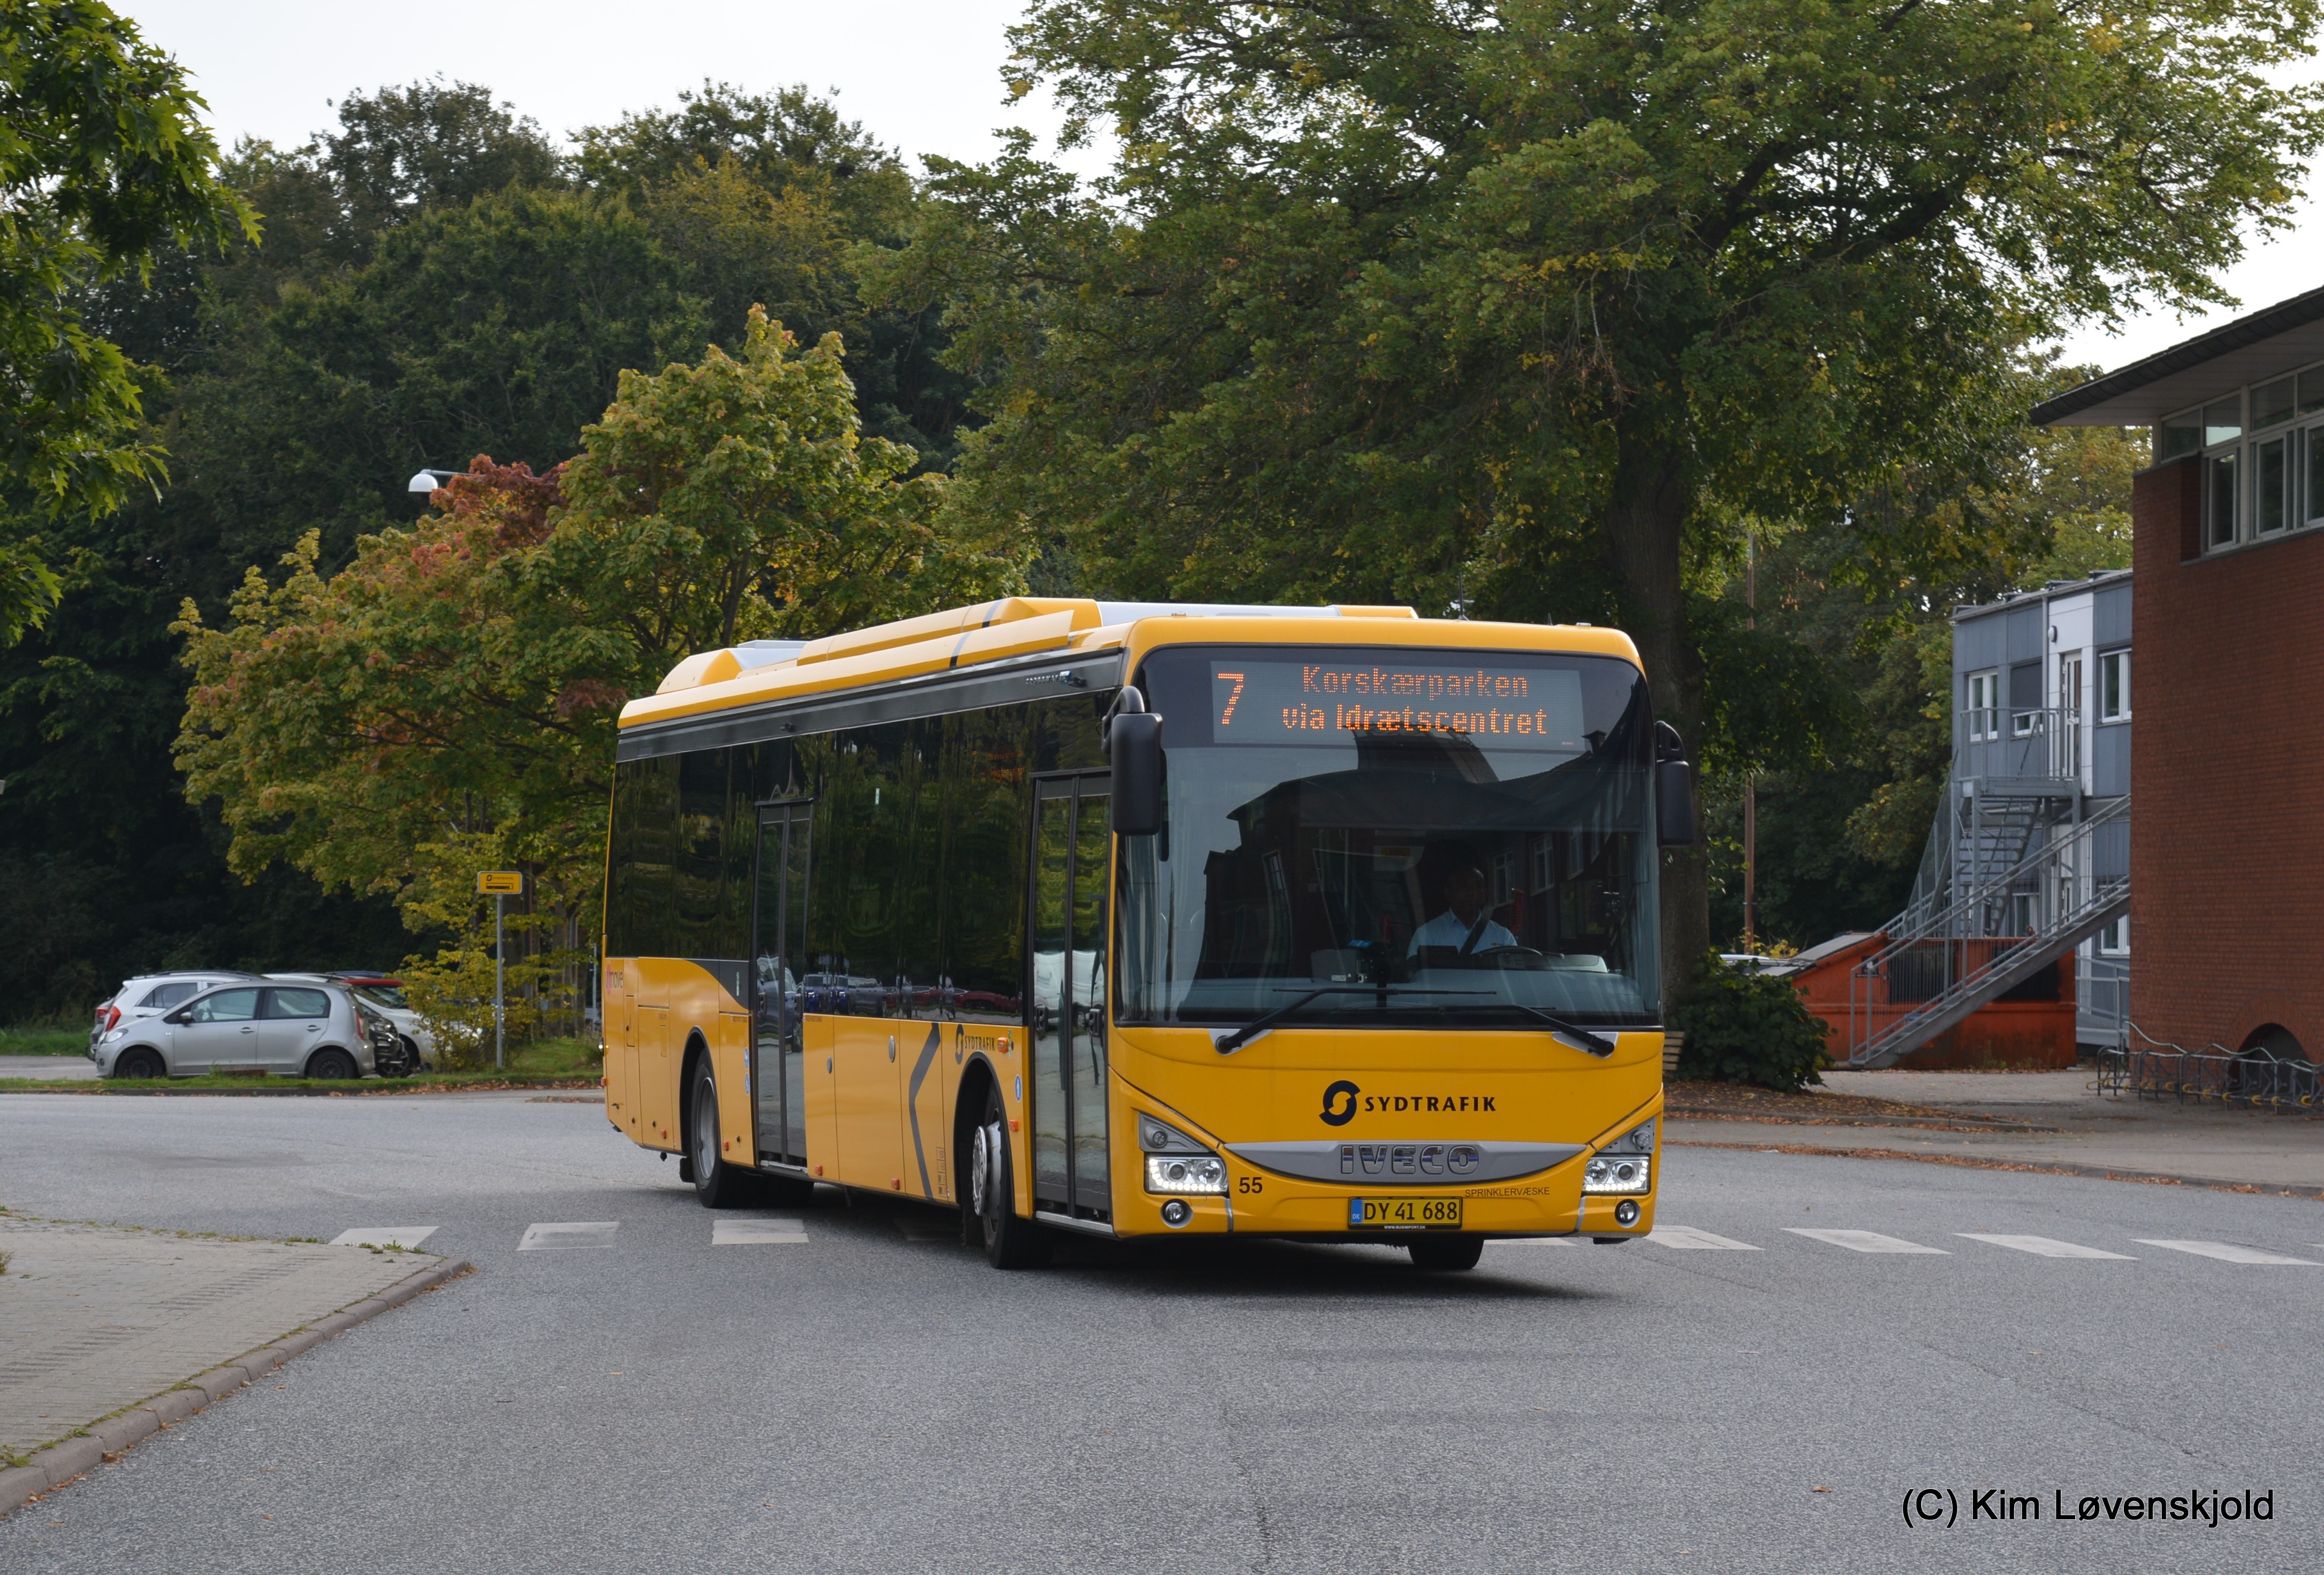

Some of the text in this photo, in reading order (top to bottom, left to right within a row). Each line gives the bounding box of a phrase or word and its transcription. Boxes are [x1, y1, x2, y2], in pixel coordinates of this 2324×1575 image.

[1303, 666, 1527, 700] Korskærparken
[1217, 673, 1244, 725] 7
[1283, 703, 1547, 734] via Idrætscentret
[964, 1035, 995, 1051] SYDTRAFIK
[1364, 1096, 1496, 1112] SYDTRAFIK
[1341, 1145, 1479, 1175] IVECO
[1239, 1177, 1263, 1194] 55
[1465, 1187, 1550, 1198] SPRINKLERVÆSKE
[1364, 1202, 1457, 1220] DY 41 688
